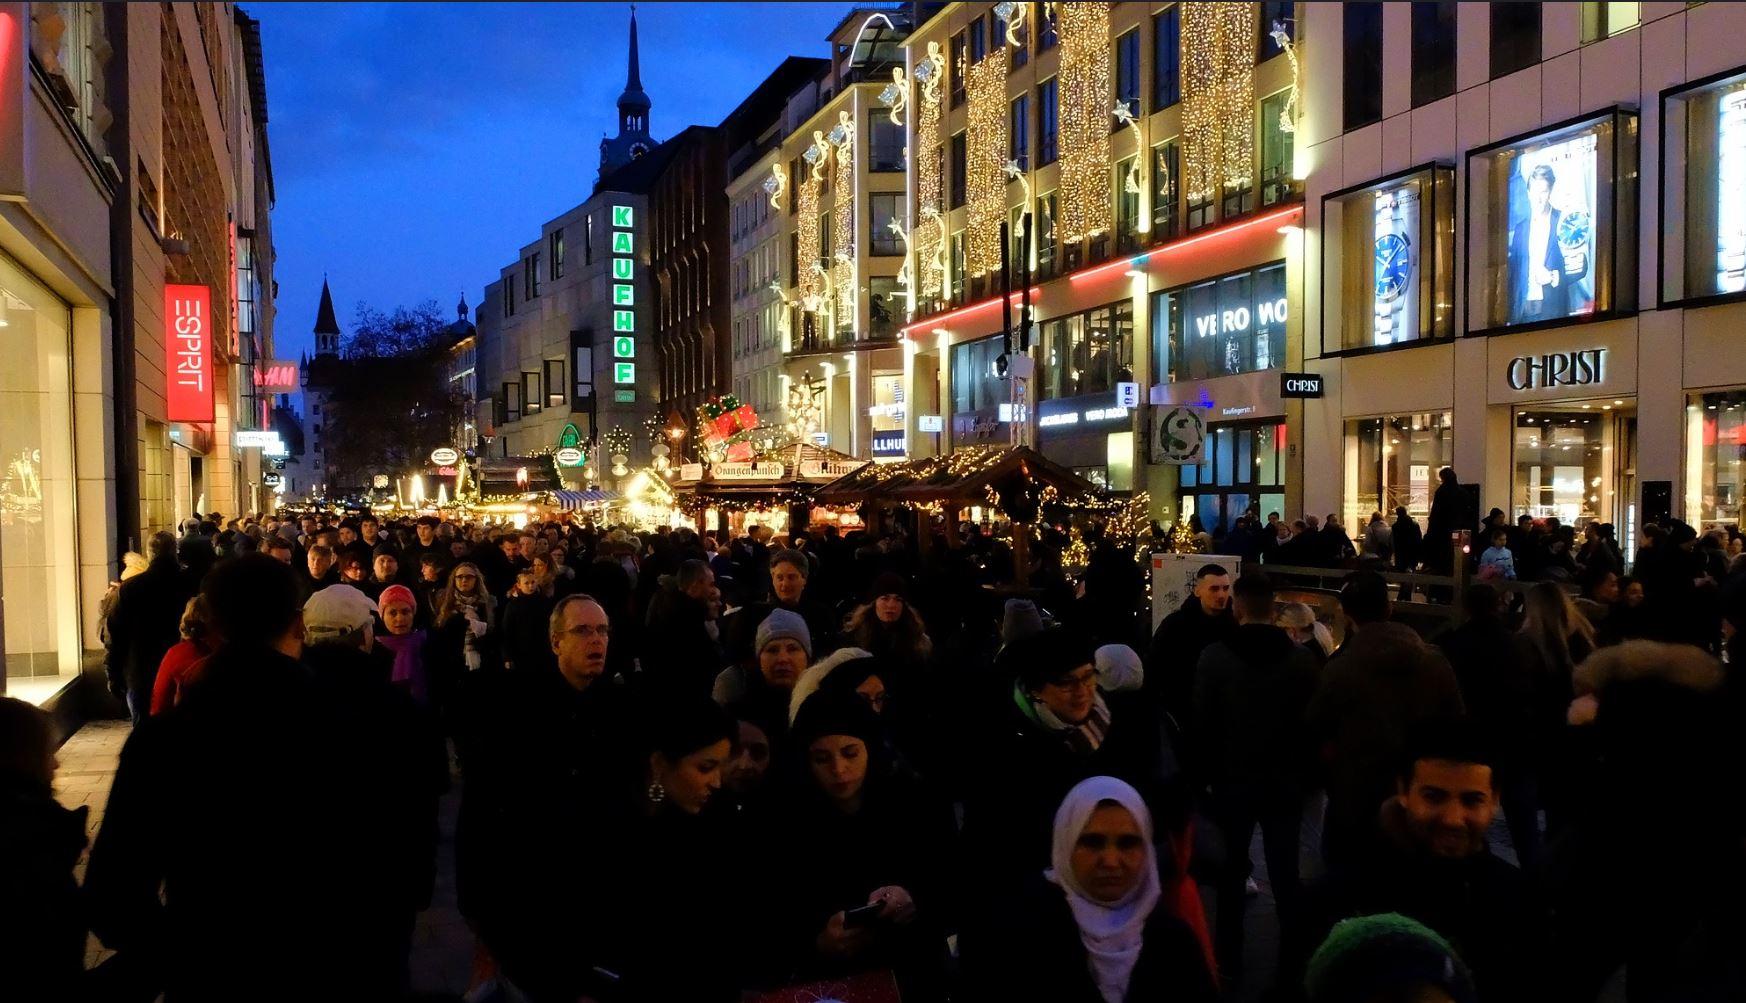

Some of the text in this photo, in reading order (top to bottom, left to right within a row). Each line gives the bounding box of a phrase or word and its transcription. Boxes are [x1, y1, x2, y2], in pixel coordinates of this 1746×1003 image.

[614, 207, 633, 382] KAUFHOF
[1196, 307, 1250, 338] VERO
[175, 299, 203, 392] ESPRIT
[1286, 379, 1319, 392] CHRIST
[1506, 348, 1607, 391] CHRIST
[873, 438, 906, 452] LLHU
